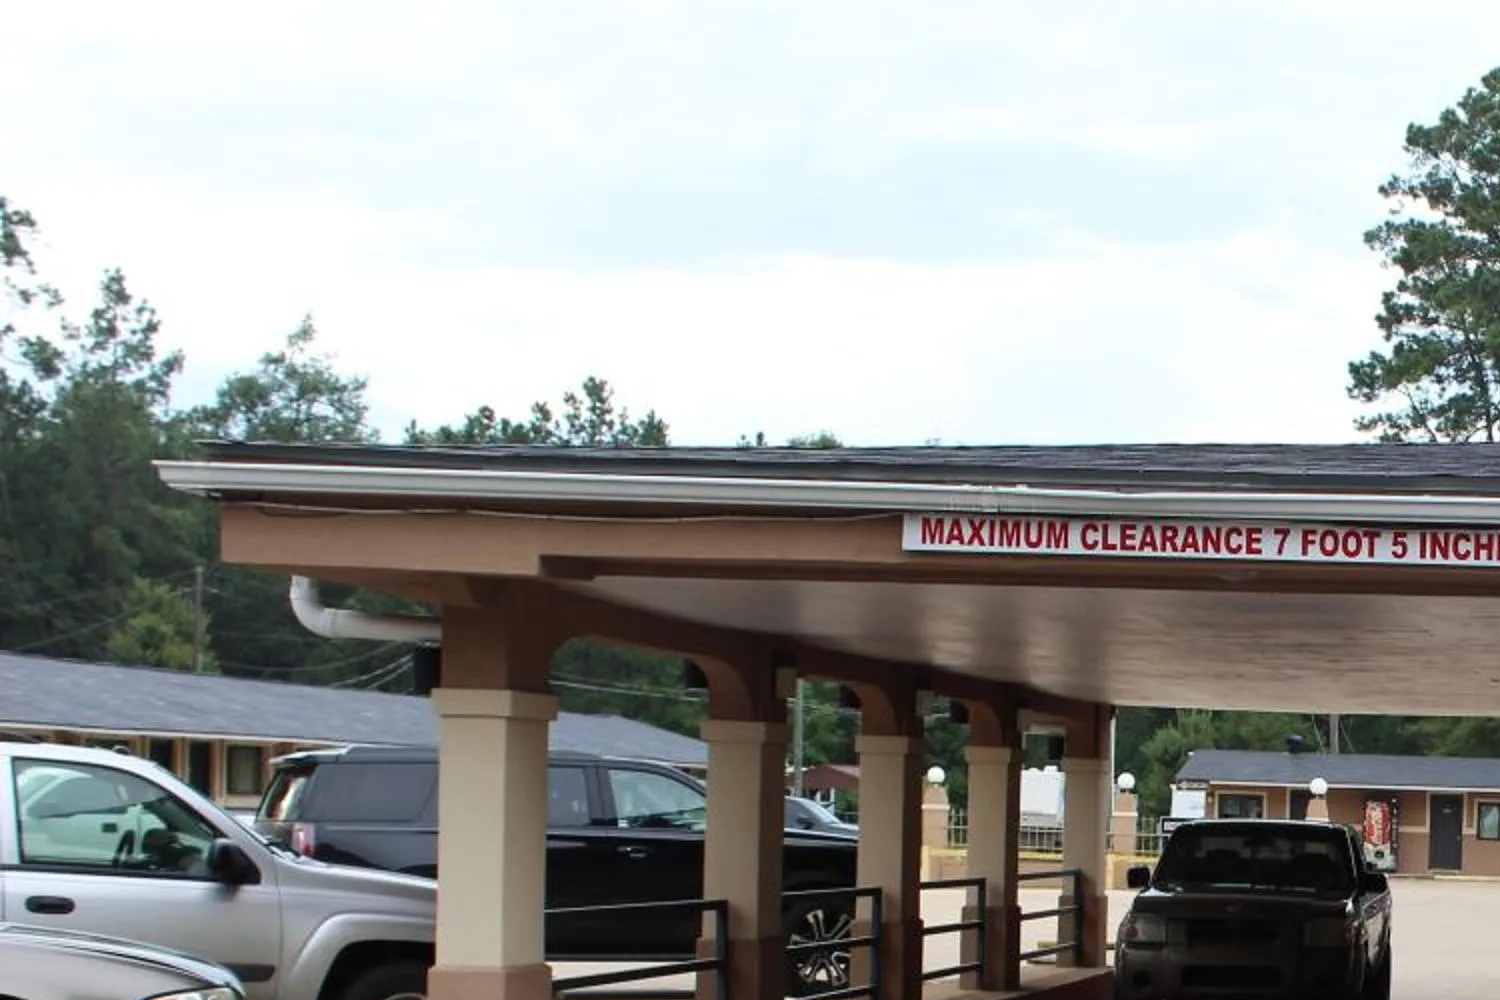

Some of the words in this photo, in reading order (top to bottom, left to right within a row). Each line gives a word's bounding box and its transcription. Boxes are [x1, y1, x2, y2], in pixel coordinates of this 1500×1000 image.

[921, 517, 1069, 549] MAXIMUM
[1080, 523, 1262, 555] CLEARANCE
[1273, 528, 1291, 556] 7
[1301, 529, 1381, 558] FOOT
[1391, 532, 1408, 560] 5
